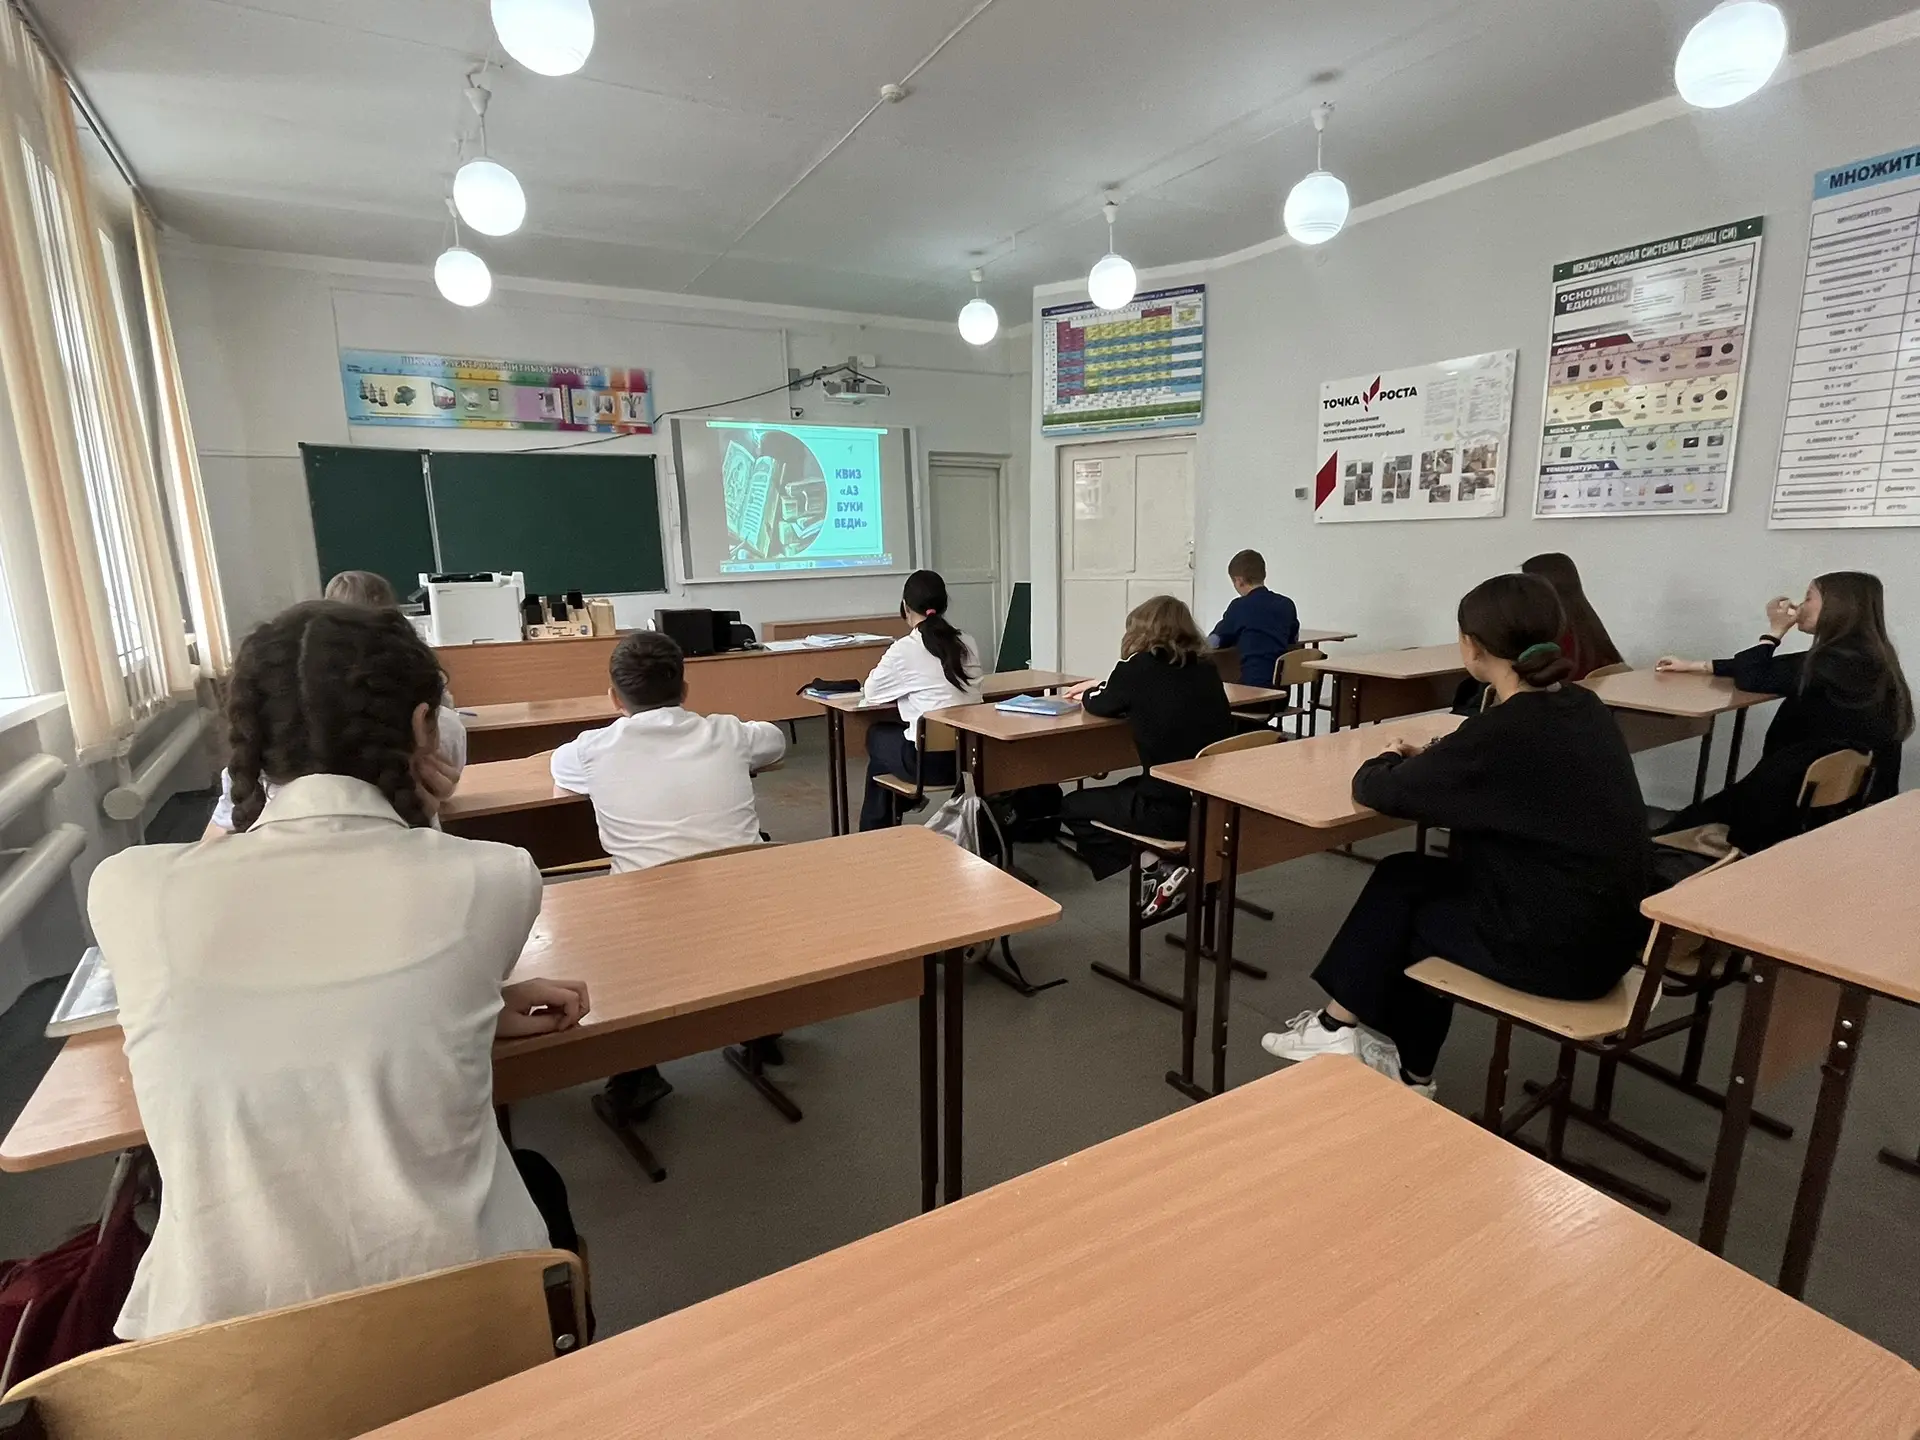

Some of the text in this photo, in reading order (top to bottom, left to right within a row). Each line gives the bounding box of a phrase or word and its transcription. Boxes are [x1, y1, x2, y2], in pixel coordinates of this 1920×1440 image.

[1572, 226, 1738, 275] МЕЖДУНАРОДНАЯ СИСТЕМА ЕДИНИЦ (СИ)
[1560, 281, 1629, 303] ОСНОВНЫЕ
[1566, 292, 1628, 311] ЕДИНИЦЫ
[1323, 386, 1418, 409] ТОЧКА РОСТА
[835, 468, 862, 480] КВИЗ
[840, 485, 859, 496] «АЗ
[837, 502, 863, 513] БУКИ
[834, 518, 868, 530] ВЕДИ»
